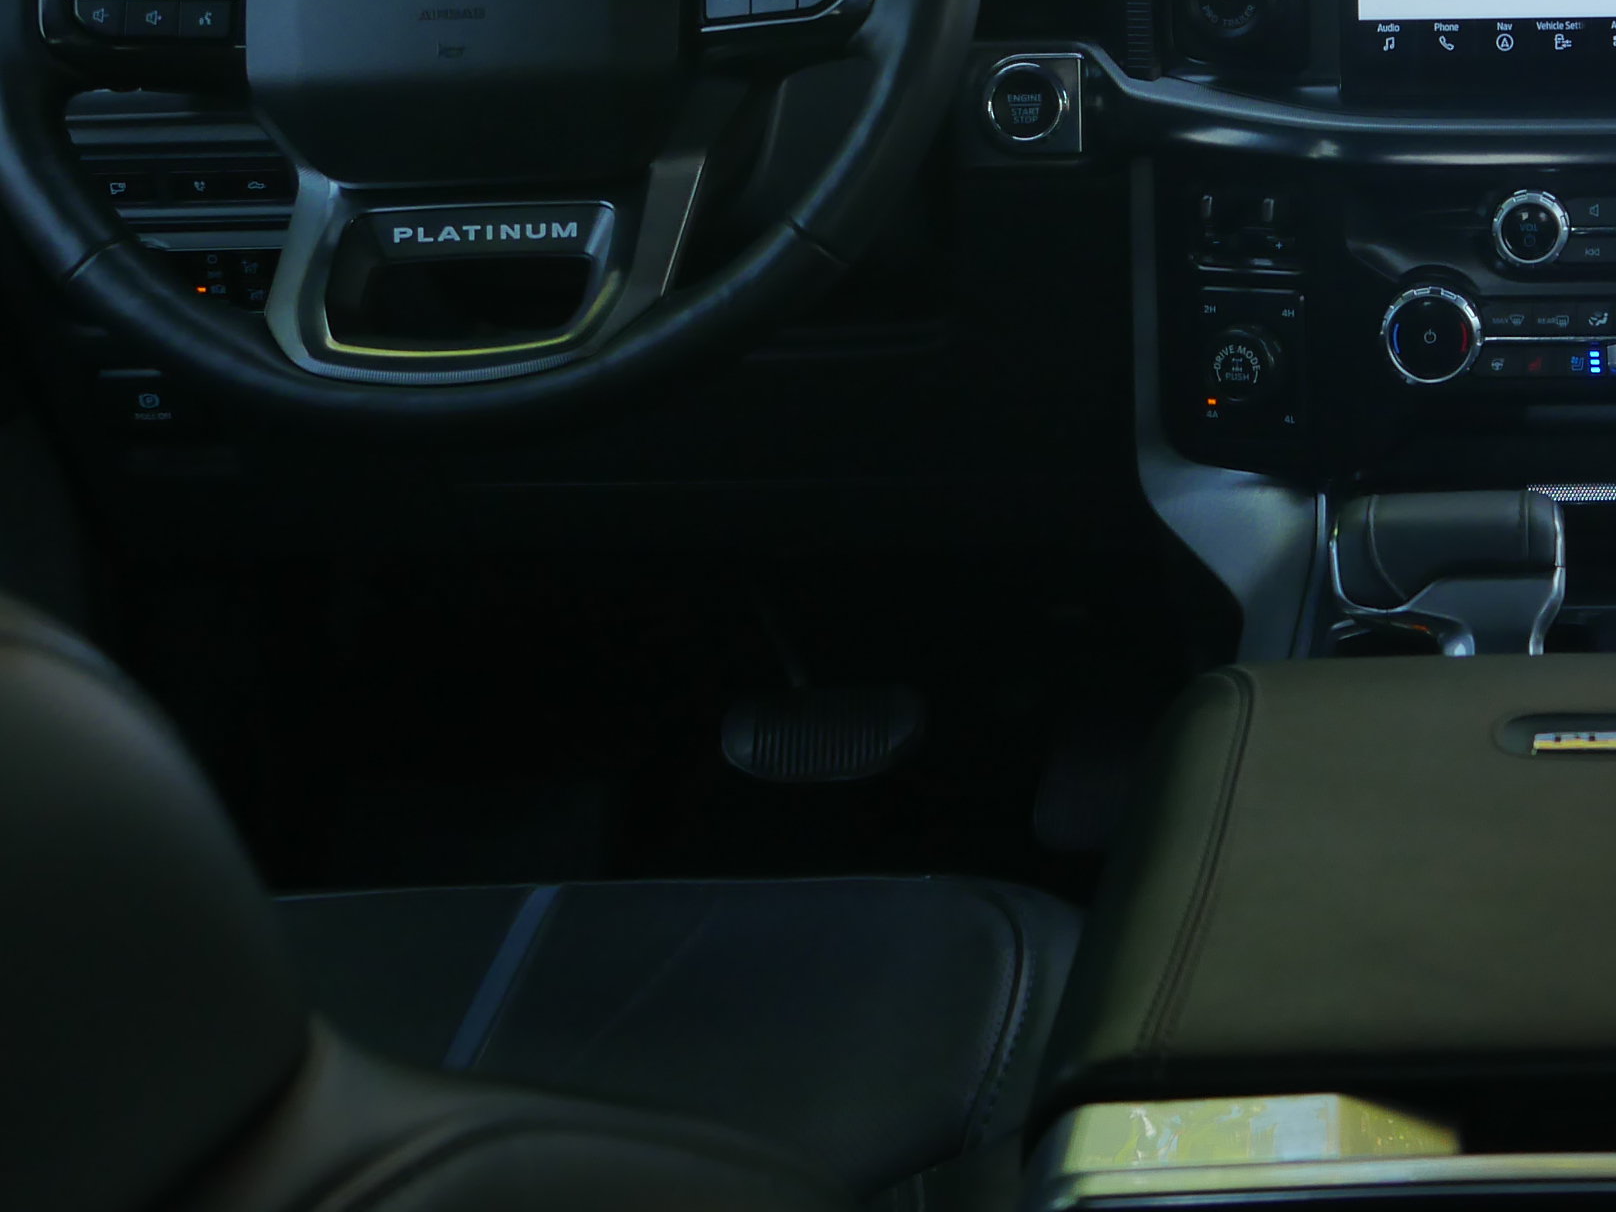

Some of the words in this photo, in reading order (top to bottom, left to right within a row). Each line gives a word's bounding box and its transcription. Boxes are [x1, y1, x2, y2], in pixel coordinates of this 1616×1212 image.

[1377, 22, 1400, 33] Audio
[1433, 21, 1459, 32] Phone
[1497, 21, 1513, 32] Nav
[1536, 21, 1564, 31] Vehicle
[1007, 93, 1042, 102] ENGINE
[1011, 107, 1040, 117] START
[1013, 116, 1039, 125] STOP
[393, 221, 578, 244] PLATINUM
[1203, 304, 1217, 315] 2H
[1281, 308, 1296, 318] 4H
[1212, 343, 1236, 372] DRIVE
[1237, 344, 1262, 372] MODE
[1224, 371, 1251, 382] PUSH
[1205, 410, 1219, 420] 4A
[1283, 415, 1297, 425] 4L
